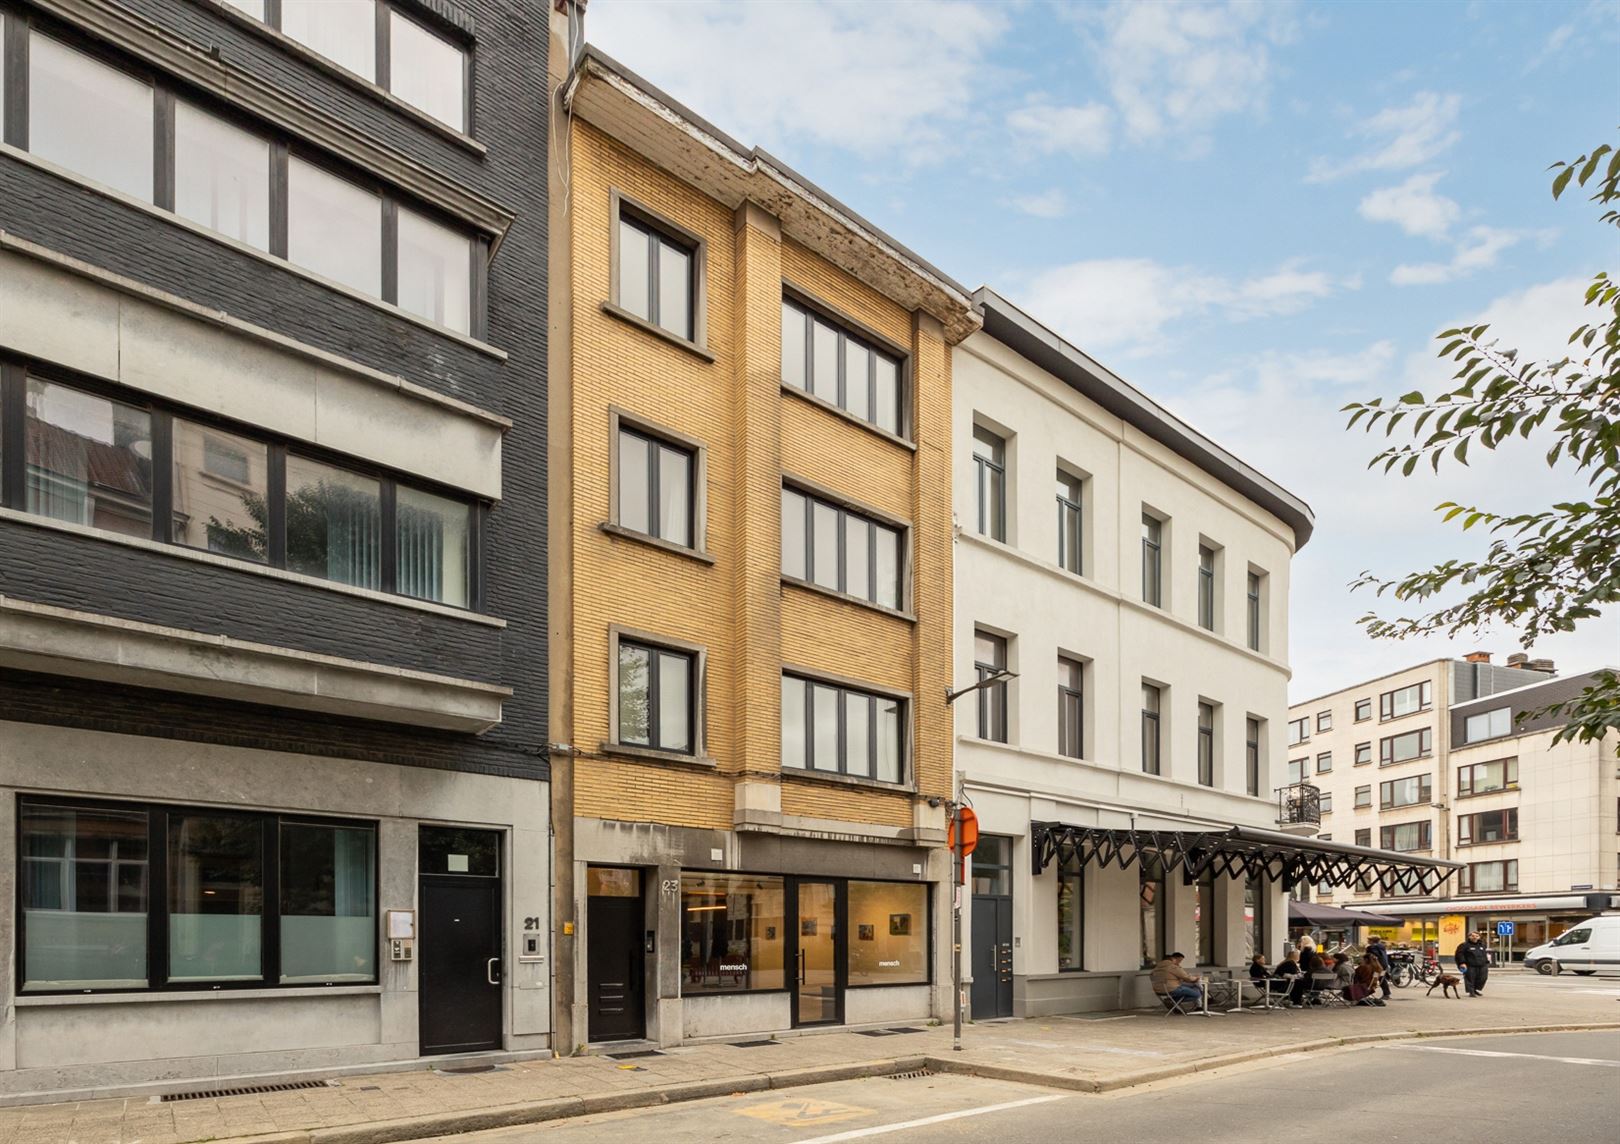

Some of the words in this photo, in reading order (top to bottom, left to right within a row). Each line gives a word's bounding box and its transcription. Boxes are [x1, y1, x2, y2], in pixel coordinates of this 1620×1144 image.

[663, 880, 678, 891] 23
[524, 916, 539, 930] 21
[720, 963, 747, 971] mensch
